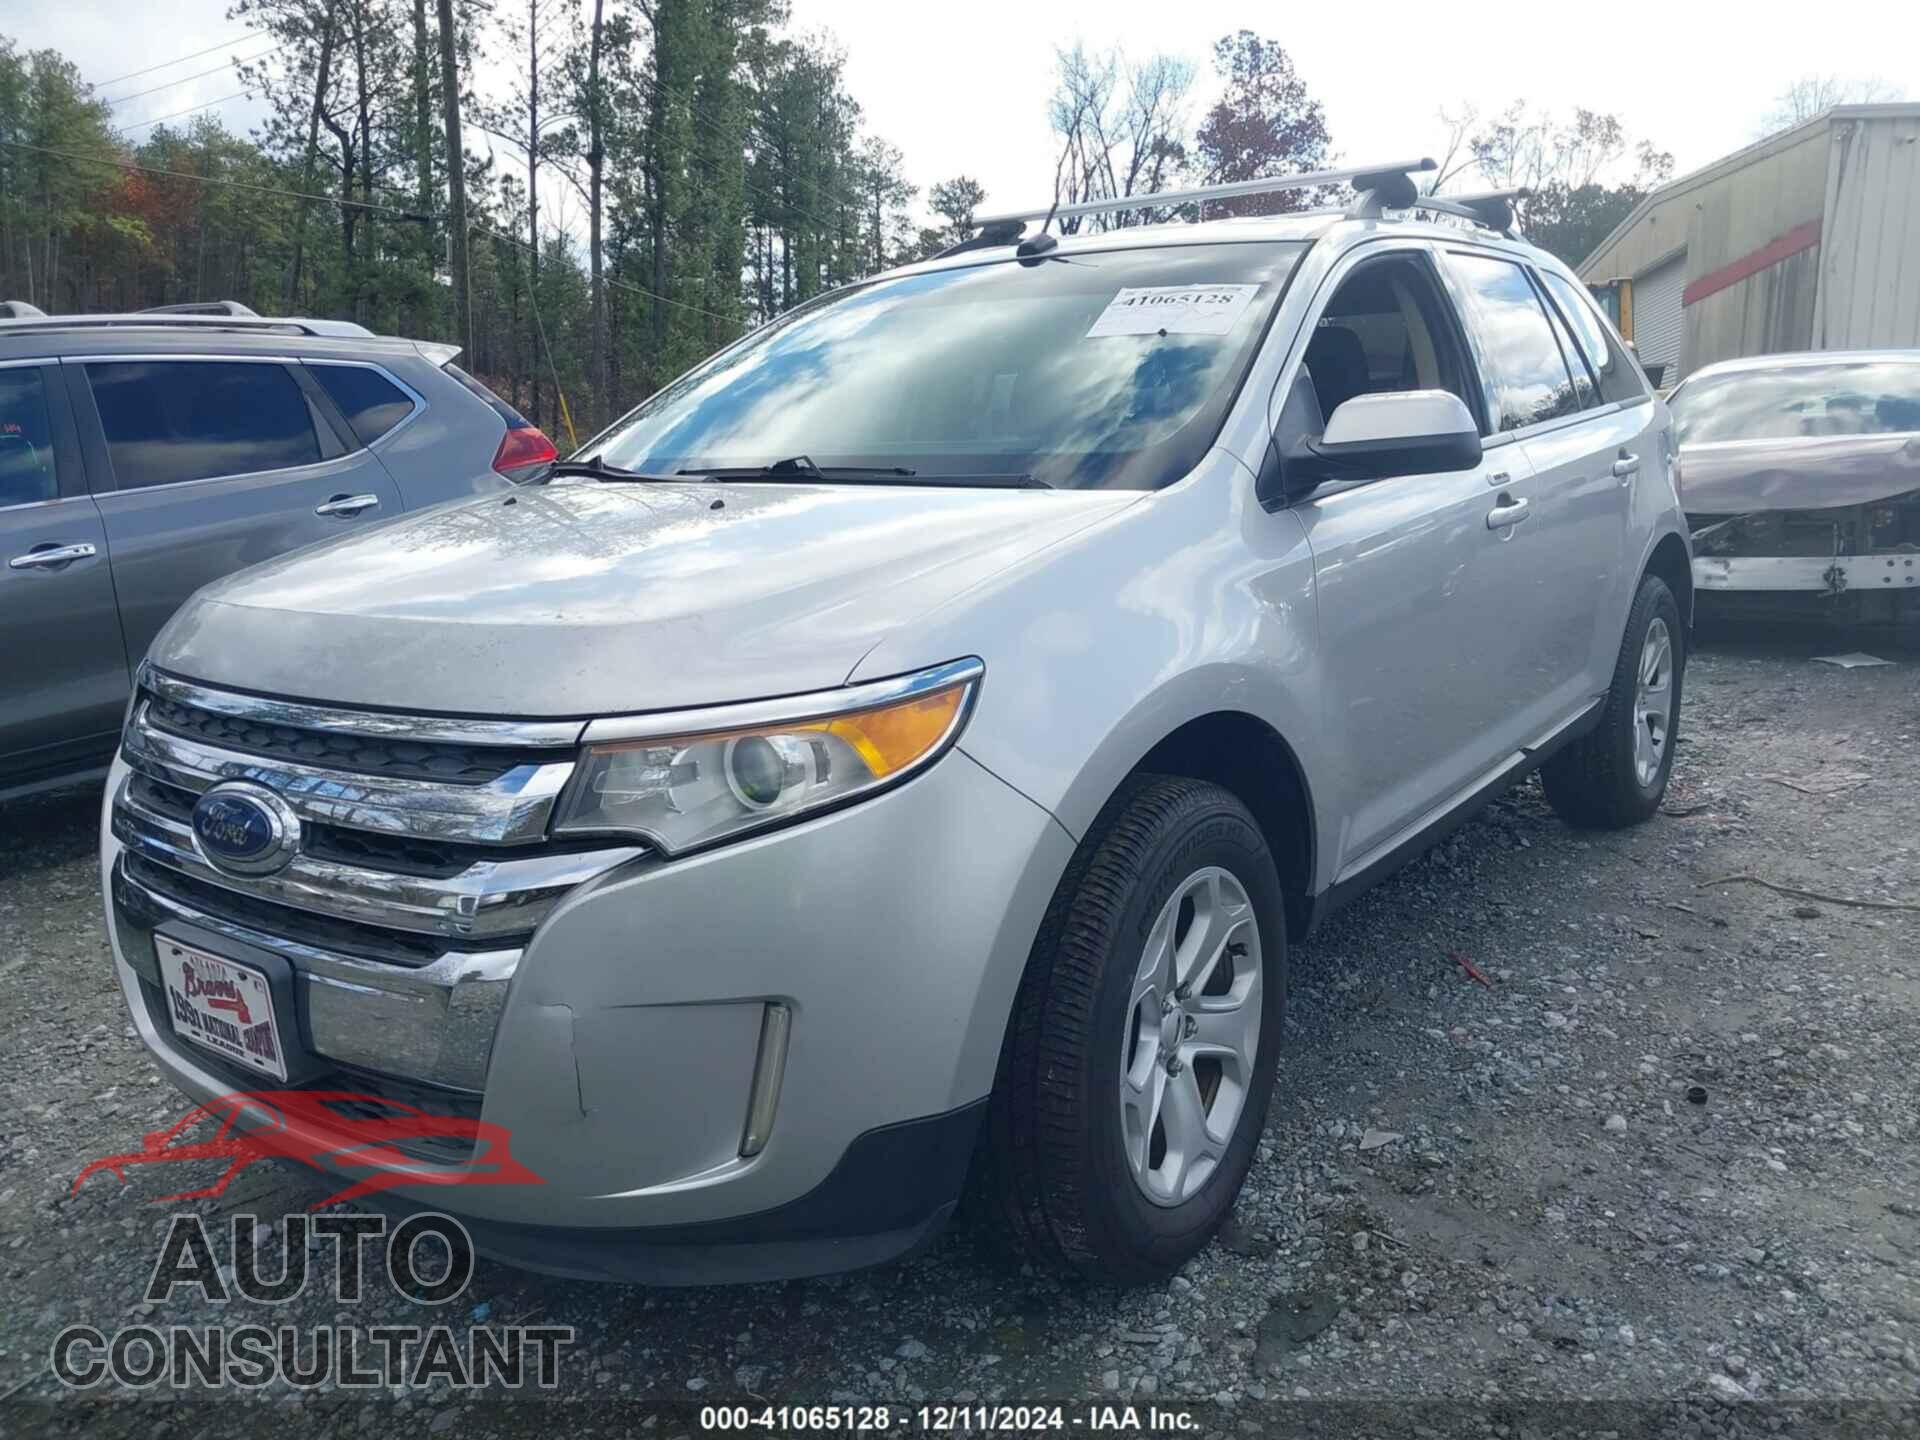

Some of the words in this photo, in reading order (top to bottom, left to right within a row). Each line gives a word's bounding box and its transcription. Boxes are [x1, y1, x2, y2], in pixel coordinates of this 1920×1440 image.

[1121, 294, 1235, 307] 41065128
[201, 801, 259, 846] Ford
[169, 984, 203, 1032] 1991
